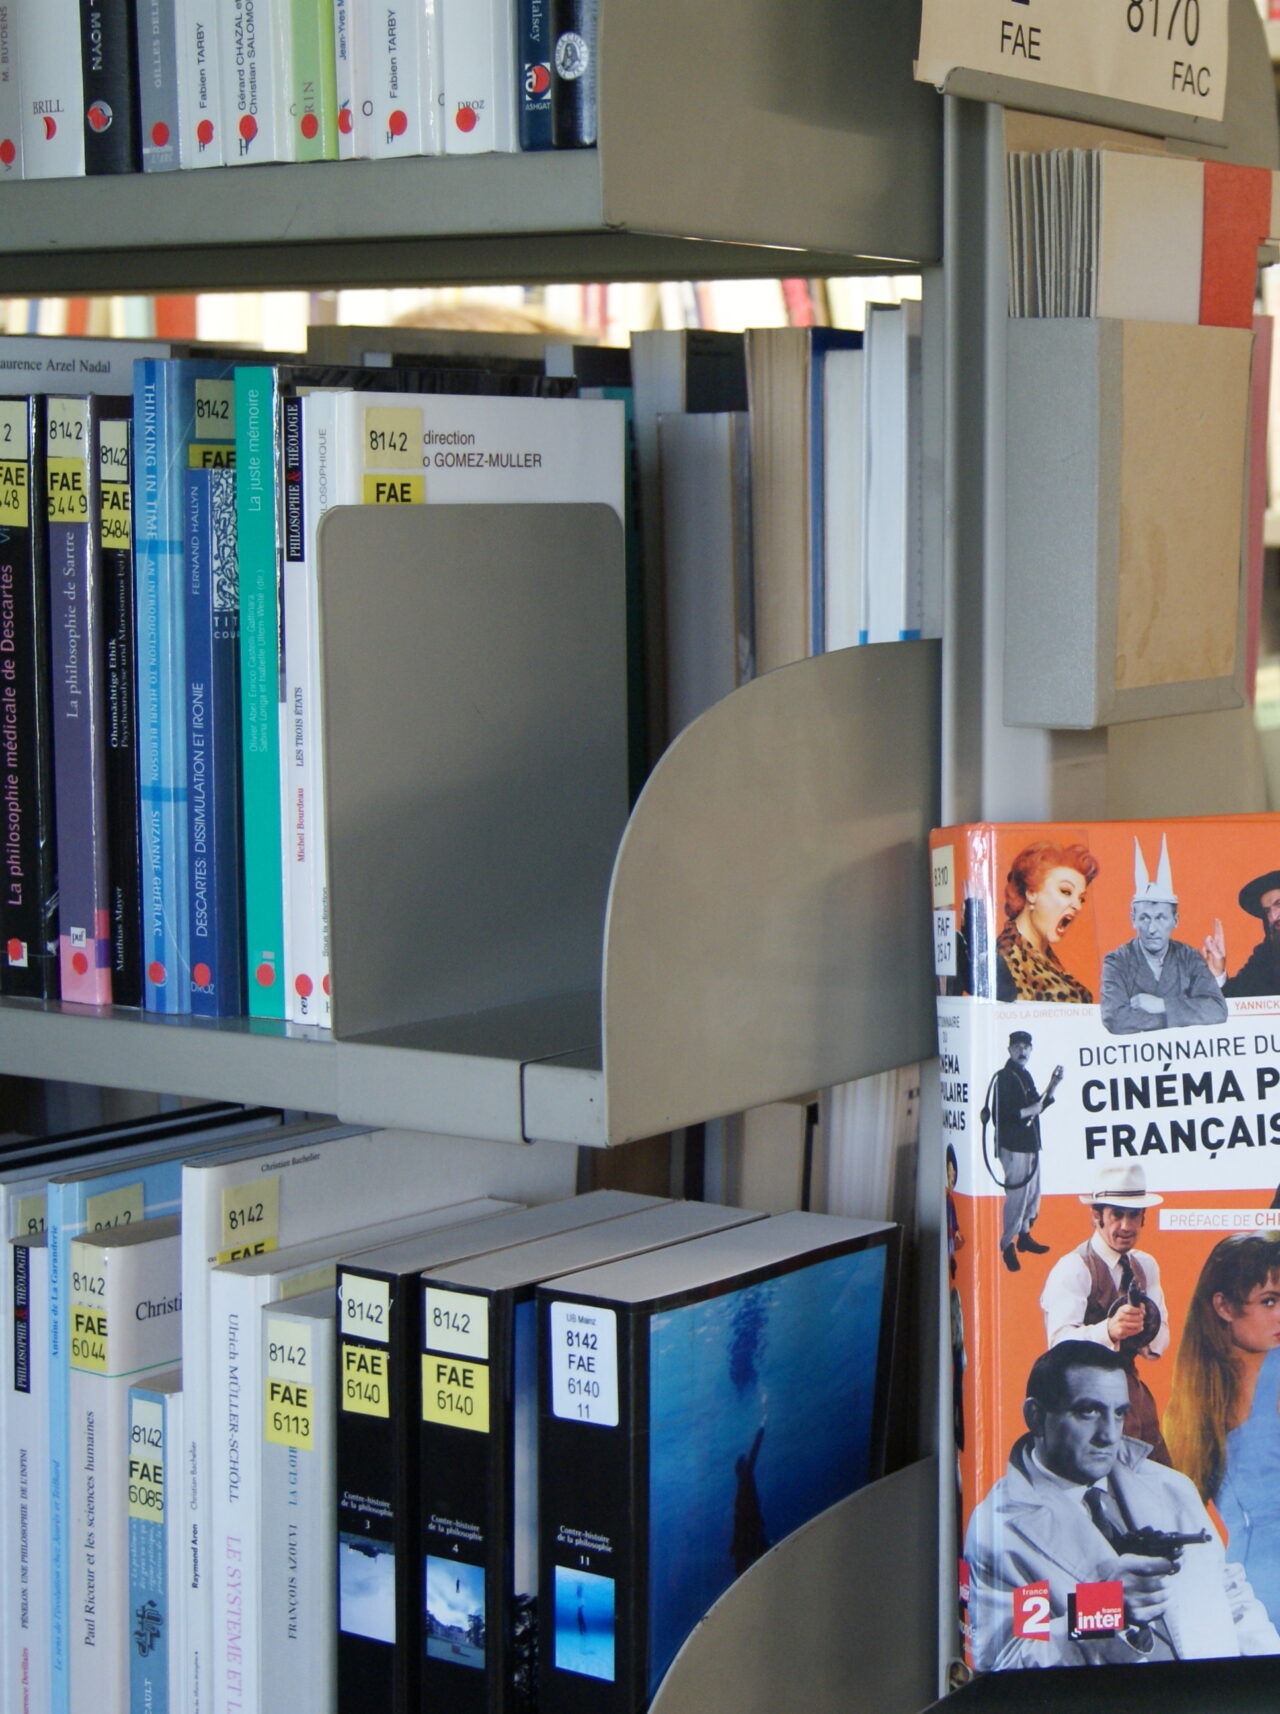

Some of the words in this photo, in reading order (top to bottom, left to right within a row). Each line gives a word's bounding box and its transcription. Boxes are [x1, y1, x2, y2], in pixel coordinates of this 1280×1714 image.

[388, 9, 396, 53] TARBY
[530, 2, 542, 42] alsey
[1126, 0, 1199, 46] 8170
[91, 12, 102, 71] MOYN
[197, 22, 205, 65] TARBY
[235, 13, 245, 66] CHAZAL
[1000, 20, 1041, 61] FAE
[237, 69, 246, 111] Gérard
[249, 61, 258, 115] Christian
[389, 57, 398, 99] Fabien
[1172, 61, 1210, 97] FAC
[33, 99, 64, 115] BRILL
[525, 102, 551, 110] ASHGAT
[0, 359, 42, 371] aurence
[46, 359, 76, 372] Arzel
[79, 360, 111, 373] Nadal
[196, 399, 229, 420] 8142
[246, 388, 260, 453] mémoire
[50, 420, 83, 440] 8142
[145, 384, 157, 469] THINKING
[287, 404, 299, 469] THÉOLOGIE
[369, 430, 408, 451] 8142
[423, 431, 475, 445] direction
[101, 446, 128, 466] 8142
[434, 452, 542, 468] GOMEZ-MULLER
[50, 472, 82, 492] FAE
[146, 474, 157, 492] IN
[249, 454, 263, 492] juste
[48, 494, 88, 516] 5449
[101, 490, 130, 511] FAE
[249, 496, 261, 513] La
[376, 483, 411, 502] FAE
[146, 501, 158, 539] TIME
[190, 486, 199, 533] HALLYN
[289, 484, 301, 558] PHILOSOPHIE
[101, 520, 129, 538] 5484
[63, 531, 76, 577] Sartre
[192, 537, 200, 595] FERNAND
[63, 582, 77, 601] de
[1, 564, 15, 652] Descartes
[148, 581, 158, 661] INTRODUCTION
[64, 605, 82, 695] philosophie
[109, 638, 117, 670] Ethik
[1, 659, 16, 681] de
[150, 670, 158, 685] TO
[67, 702, 79, 718] La
[110, 674, 119, 748] Ohnmächtige
[150, 689, 158, 724] HENRI
[192, 683, 204, 729] IRONIE
[294, 687, 302, 718] ÉTATS
[3, 687, 18, 768] médicale
[193, 732, 204, 748] ET
[295, 721, 304, 750] TROIS
[151, 728, 159, 781] BERGSON
[296, 752, 304, 767] LES
[193, 750, 207, 853] DISSIMULATION
[296, 788, 305, 829] Bourdeau
[6, 773, 24, 878] philosophie
[151, 811, 160, 872] SUZANNE
[296, 832, 305, 863] Michel
[8, 880, 22, 905] La
[115, 887, 125, 925] Mayer
[152, 877, 162, 937] GUERLAC
[72, 931, 84, 945] puf
[937, 917, 950, 937] FAF
[116, 928, 125, 972] Matthias
[1235, 999, 1280, 1011] YANNICK
[1079, 1035, 1247, 1067] DICTIONNAIRE
[1081, 1062, 1246, 1114] CINÉMA
[229, 1203, 264, 1230] 8142
[1169, 1211, 1230, 1228] PRÉFACE
[1233, 1214, 1251, 1228] DE
[15, 1247, 26, 1306] THÉOLOGIE
[72, 1272, 105, 1296] 8142
[75, 1314, 108, 1336] FAE
[347, 1299, 383, 1324] 8142
[433, 1307, 470, 1333] 8142
[51, 1320, 59, 1359] Antoine
[72, 1338, 106, 1361] 6044
[228, 1313, 240, 1364] Ulrich
[566, 1331, 598, 1350] 8142
[16, 1321, 27, 1388] PHILOSOPHIE
[269, 1343, 307, 1366] 8142
[346, 1351, 382, 1375] FAE
[568, 1354, 595, 1373] FAE
[437, 1364, 474, 1389] FAE
[568, 1378, 599, 1398] 6140
[270, 1383, 308, 1408] FAE
[347, 1379, 380, 1404] 6140
[437, 1390, 474, 1416] 6140
[273, 1413, 310, 1436] 6113
[578, 1404, 590, 1419] 11
[84, 1410, 95, 1472] humaines
[132, 1425, 162, 1448] 8142
[228, 1368, 241, 1503] MÜLLER-SCHÖLL
[129, 1460, 163, 1484] FAE
[84, 1475, 95, 1528] sciences
[129, 1485, 163, 1511] 6085
[20, 1504, 29, 1564] PHILOSOPHIE
[365, 1520, 371, 1529] 3
[84, 1532, 95, 1549] les
[226, 1536, 242, 1562] LE
[287, 1524, 298, 1572] AZOUVI
[452, 1543, 459, 1553] 4
[85, 1553, 95, 1565] et
[191, 1547, 199, 1589] Raymond
[580, 1555, 590, 1566] 11
[84, 1569, 96, 1615] Ricœur
[1022, 1588, 1049, 1596] france
[287, 1576, 299, 1640] FRANÇOIS
[1021, 1597, 1050, 1634] 2
[1078, 1611, 1122, 1629] inter
[84, 1619, 96, 1647] Paul
[226, 1669, 242, 1697] ET
